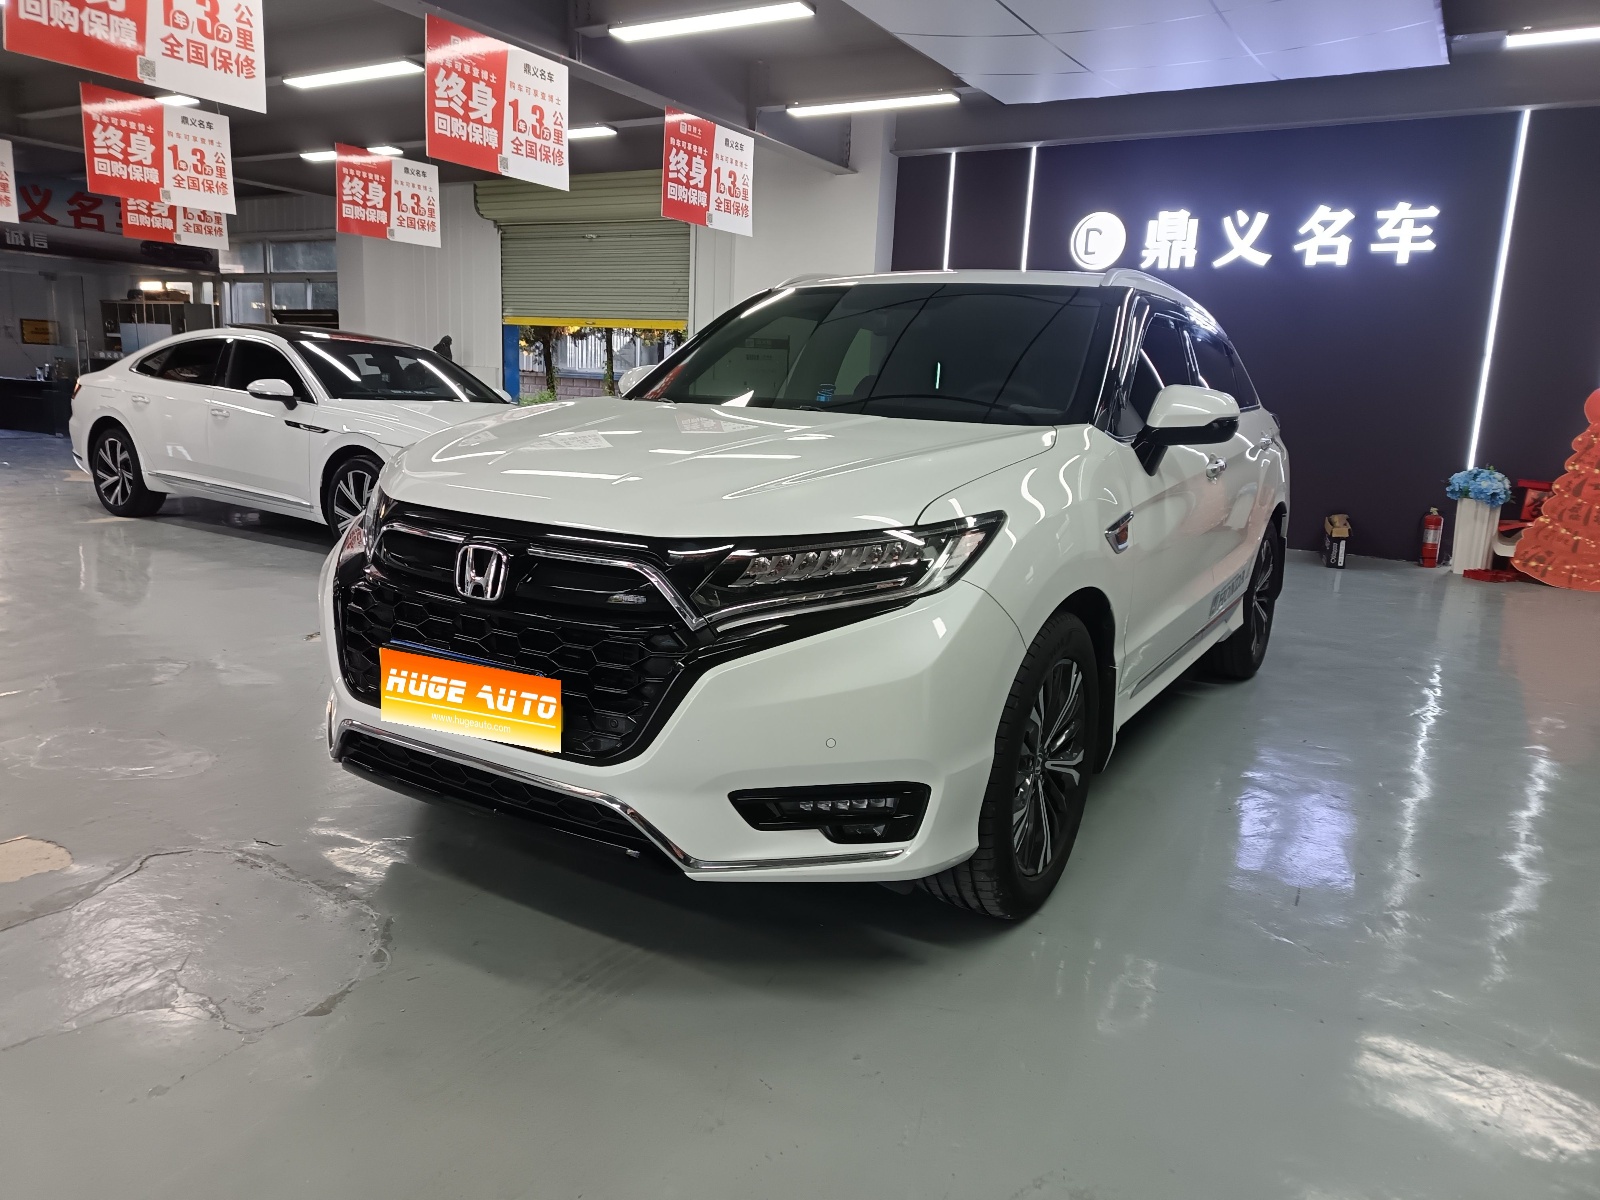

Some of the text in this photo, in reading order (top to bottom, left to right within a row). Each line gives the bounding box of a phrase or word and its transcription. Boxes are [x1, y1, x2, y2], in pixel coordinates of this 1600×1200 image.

[18, 0, 138, 48] 回购保障
[160, 33, 257, 80] 全国保修
[523, 62, 555, 83] 鼎义名车
[434, 67, 497, 123] 终身
[180, 115, 214, 131] 鼎义名车
[434, 111, 498, 149] 回购保障
[92, 123, 155, 165] 终身
[511, 136, 565, 167] 全国保修
[93, 157, 160, 185] 回购保障
[668, 147, 708, 188] 终身
[172, 174, 229, 196] 全国保修
[342, 175, 386, 209] 终身
[667, 181, 708, 208] 回购保障
[342, 202, 388, 225] 回购保障
[714, 196, 750, 218] 全国保修
[127, 211, 174, 231] 回购保障
[182, 221, 224, 238] 全国保修
[396, 214, 437, 232] 全国保修
[5, 228, 48, 249] 诚信
[1140, 201, 1441, 270] 鼎义名车
